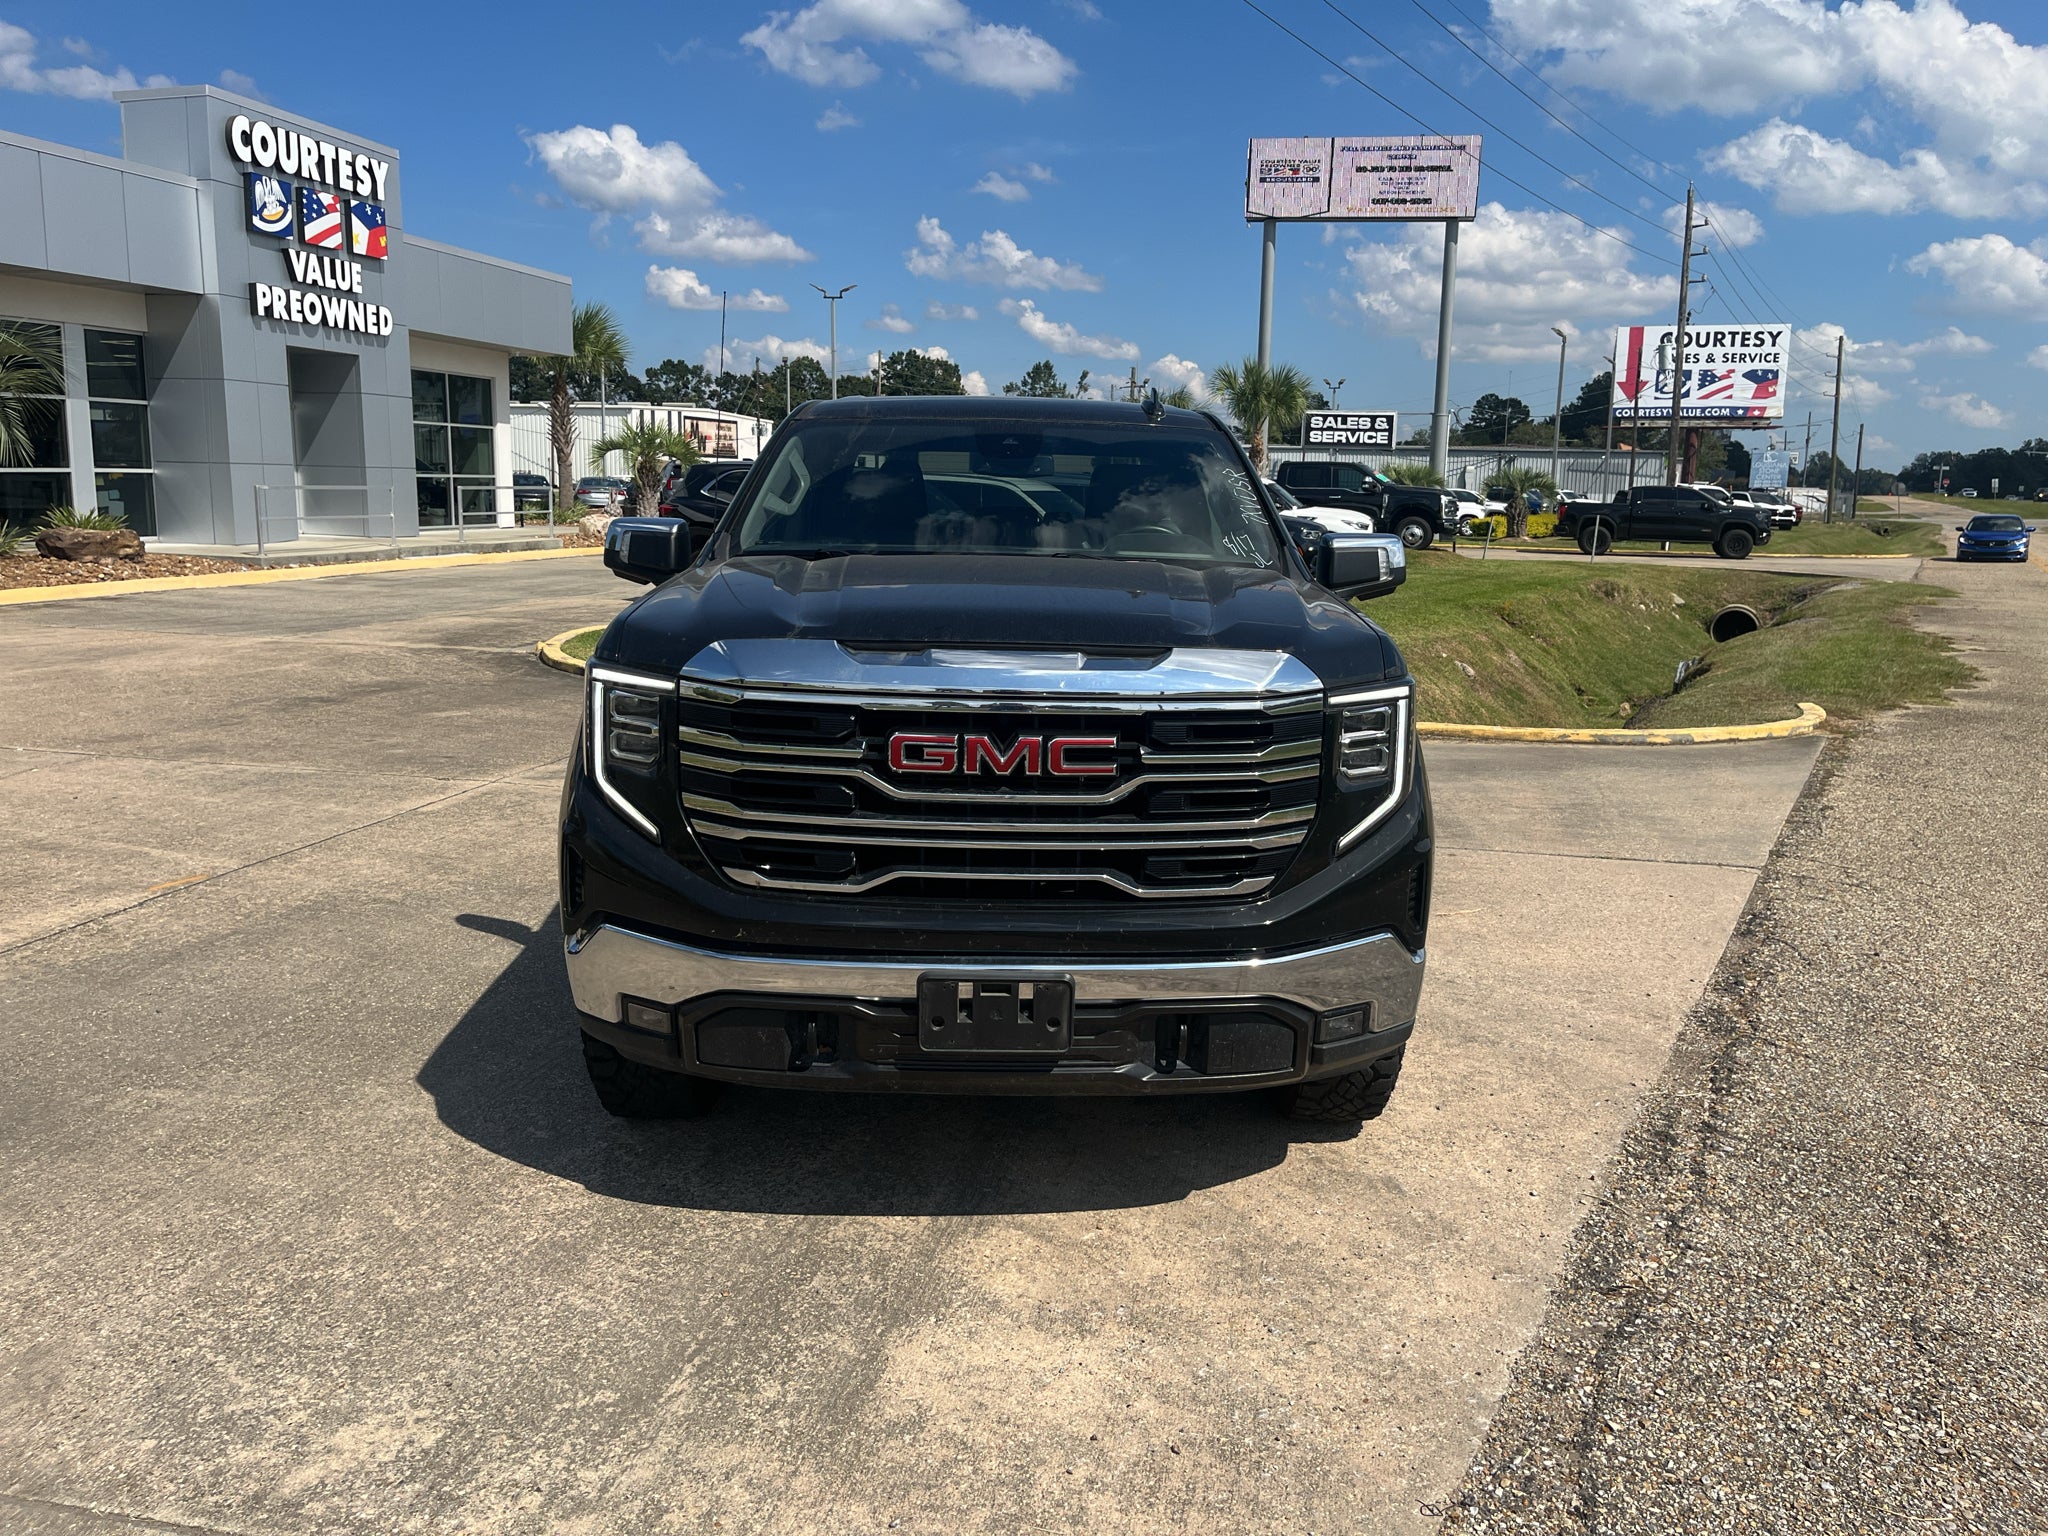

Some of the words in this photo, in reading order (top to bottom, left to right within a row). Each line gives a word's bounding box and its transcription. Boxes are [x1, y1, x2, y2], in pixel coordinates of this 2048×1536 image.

[229, 114, 389, 201] COURTESY
[287, 248, 363, 294] VALUE
[254, 282, 393, 337] PREOWNED
[1705, 353, 1716, 363] &
[1721, 352, 1780, 364] SERVICE
[1309, 430, 1389, 444] SERVICE
[1310, 416, 1371, 430] SALES
[1374, 417, 1389, 430] &
[888, 732, 1118, 776] GMC
